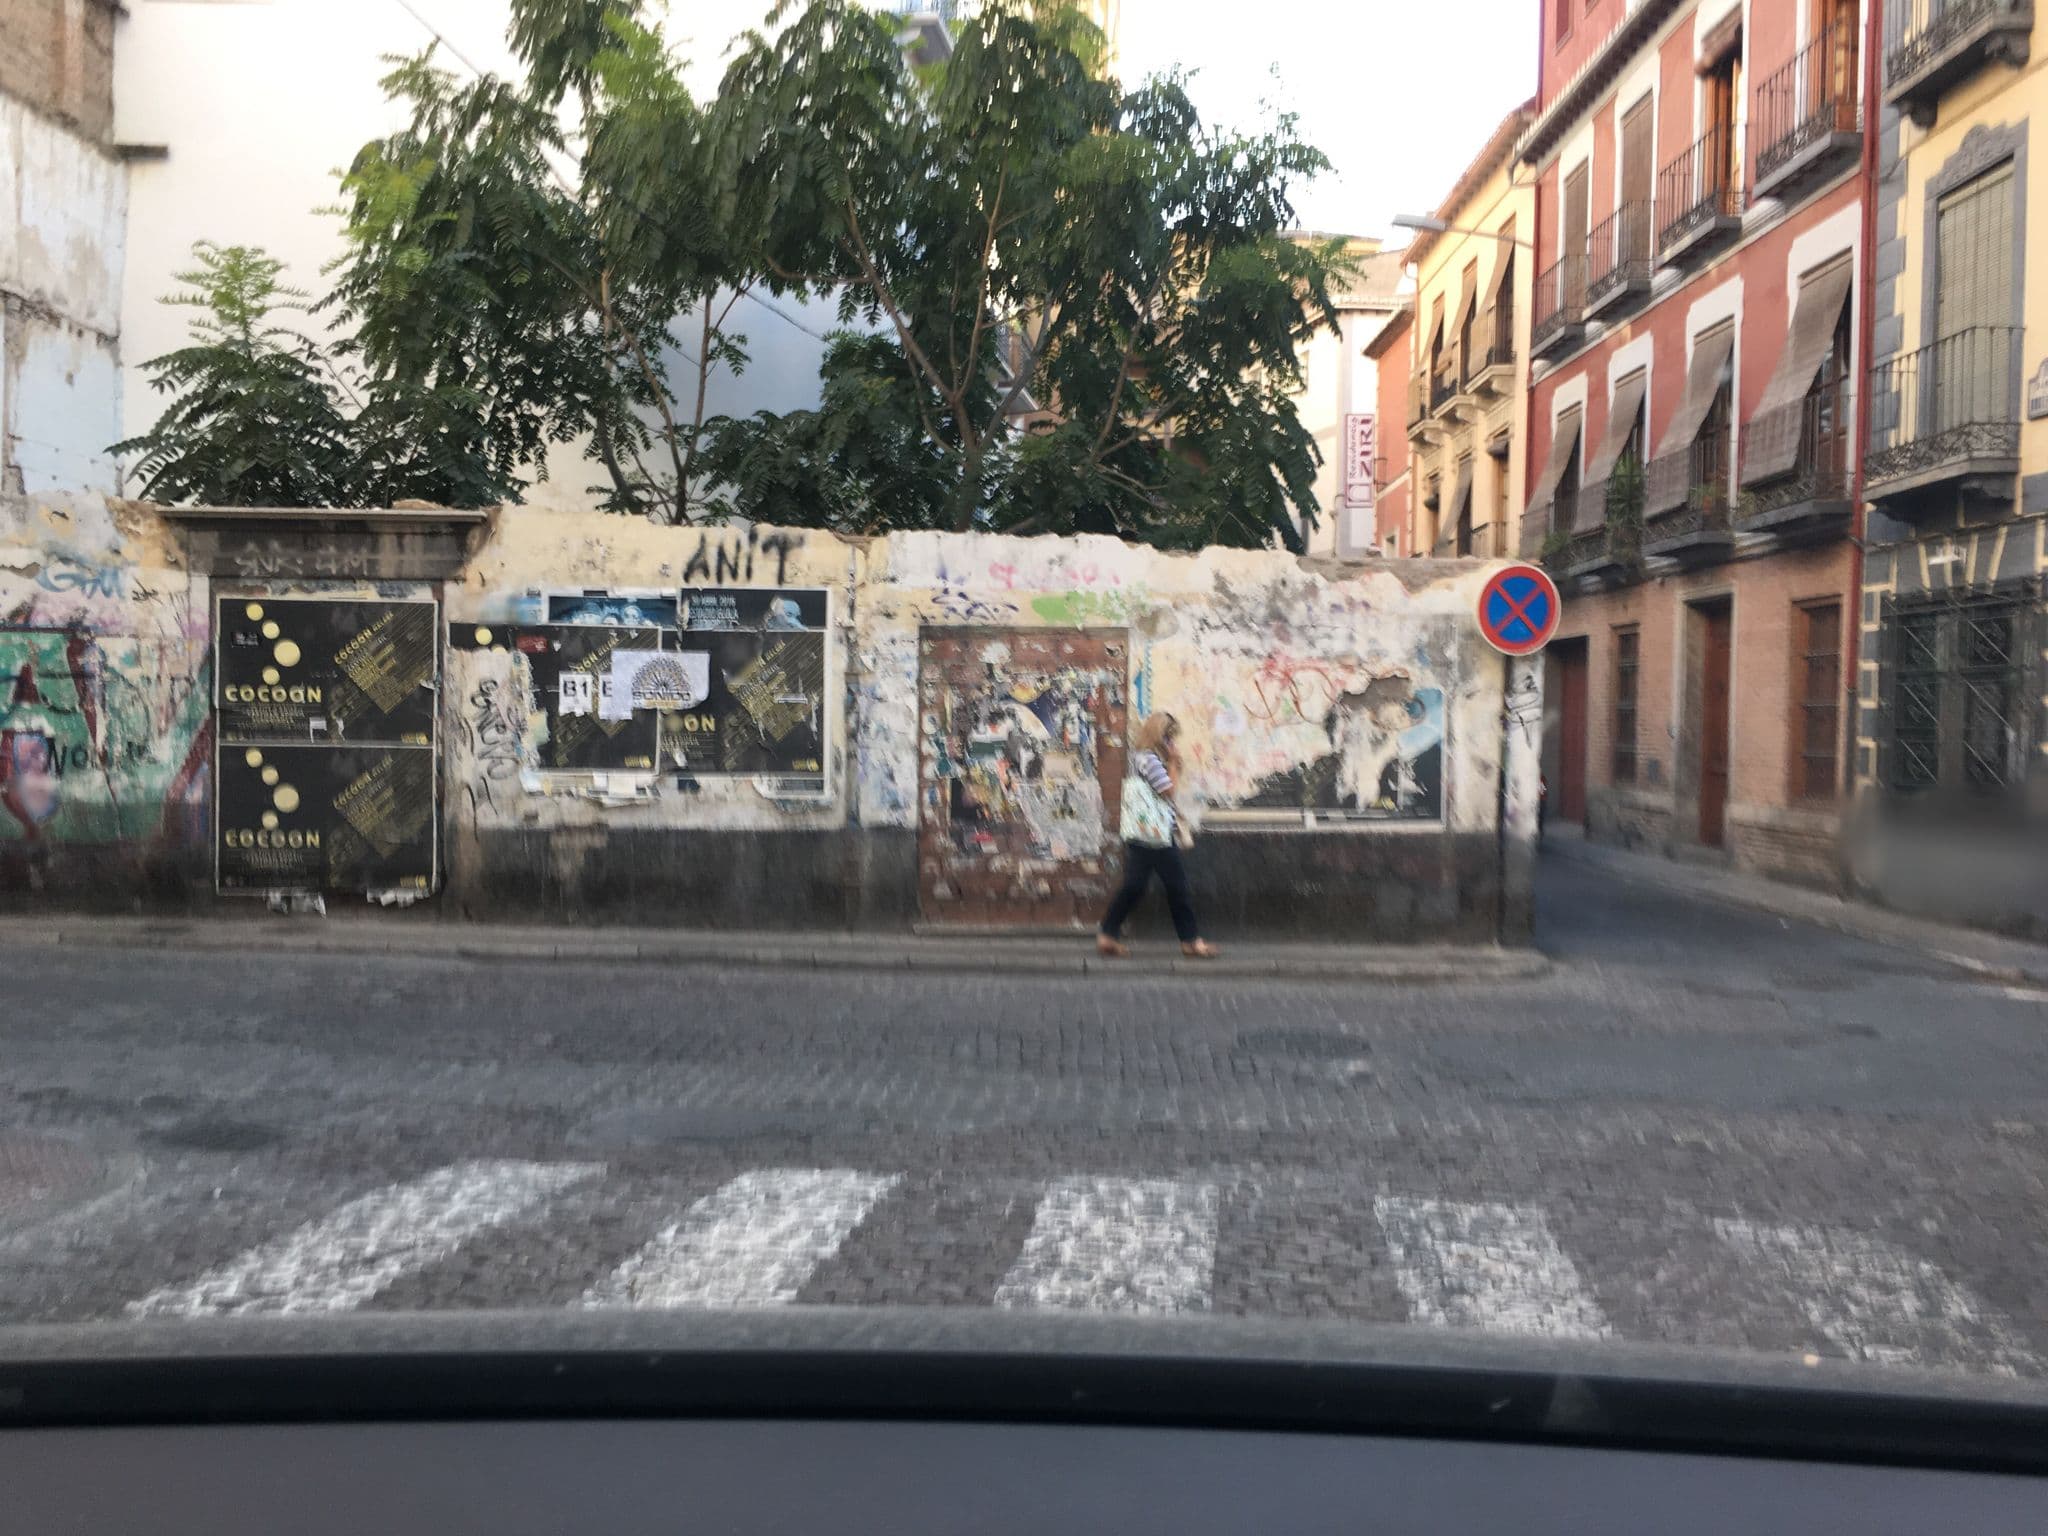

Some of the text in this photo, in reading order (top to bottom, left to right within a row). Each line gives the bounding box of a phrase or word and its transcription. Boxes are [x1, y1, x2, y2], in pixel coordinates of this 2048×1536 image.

[1360, 418, 1373, 477] ZIRI
[224, 685, 322, 704] COCOON
[224, 829, 320, 849] COCOON
